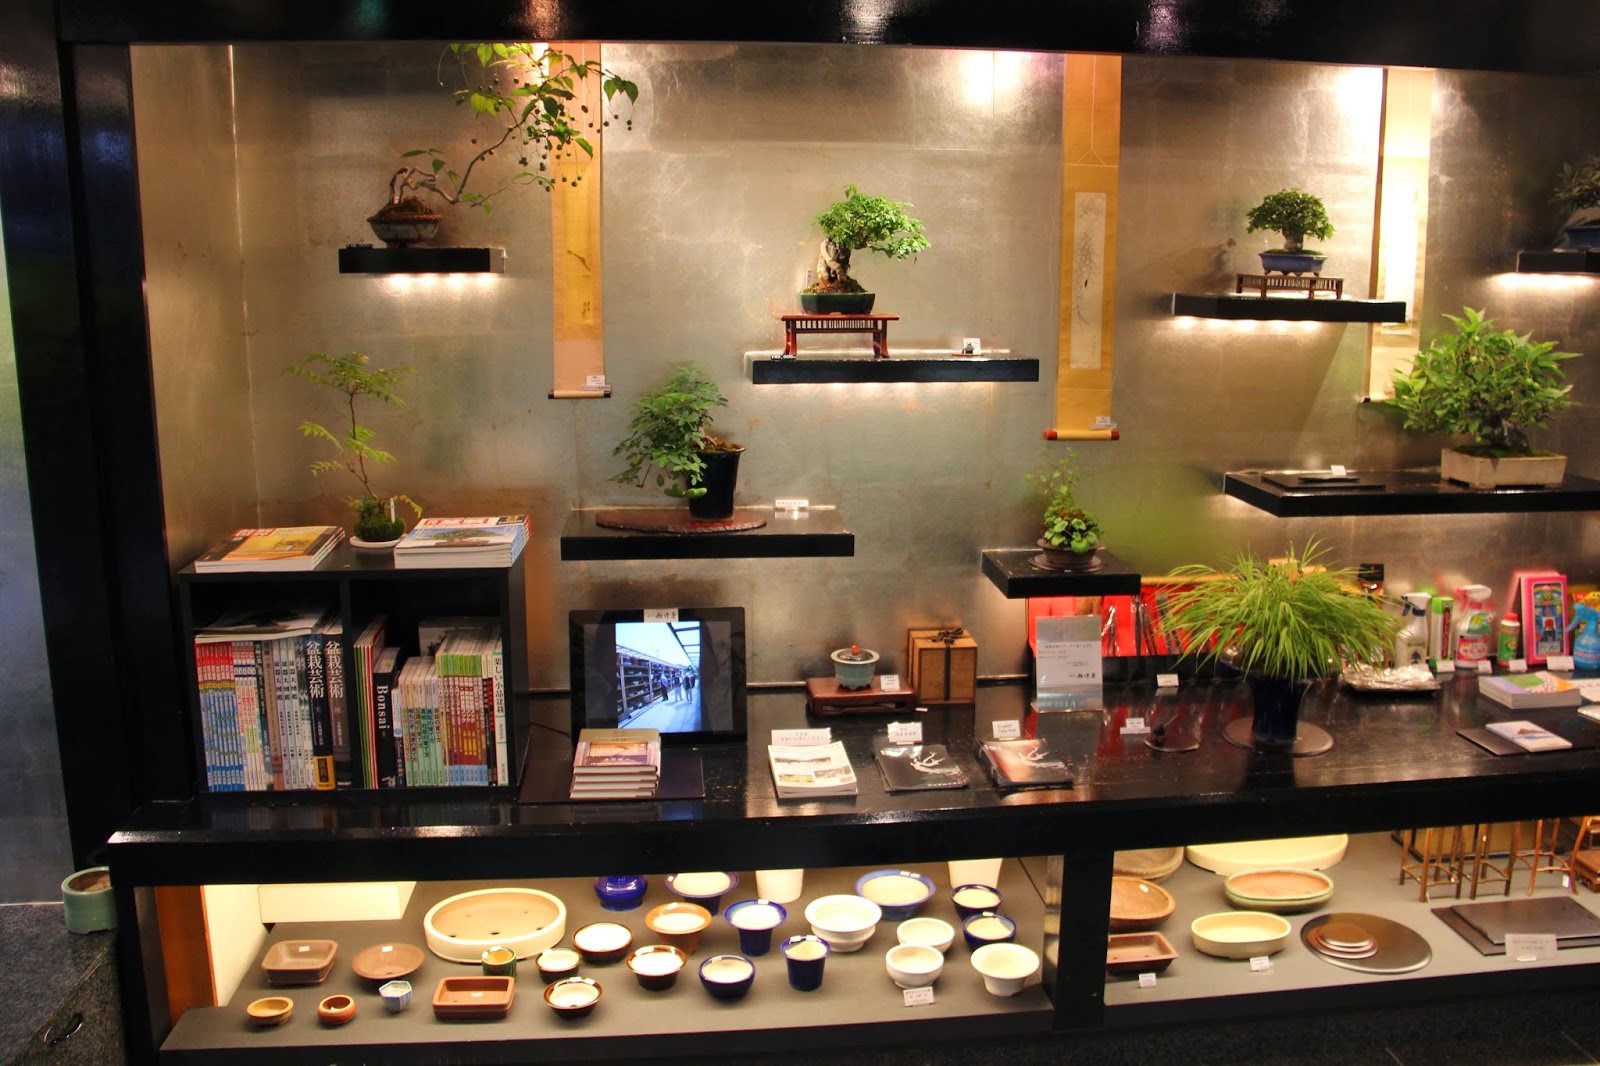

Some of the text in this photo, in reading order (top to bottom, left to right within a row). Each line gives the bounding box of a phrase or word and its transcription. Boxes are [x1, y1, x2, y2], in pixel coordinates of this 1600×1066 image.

[306, 641, 324, 698] 盆栽芸術
[326, 641, 344, 698] 盆栽芸術
[377, 685, 390, 729] Bonsai
